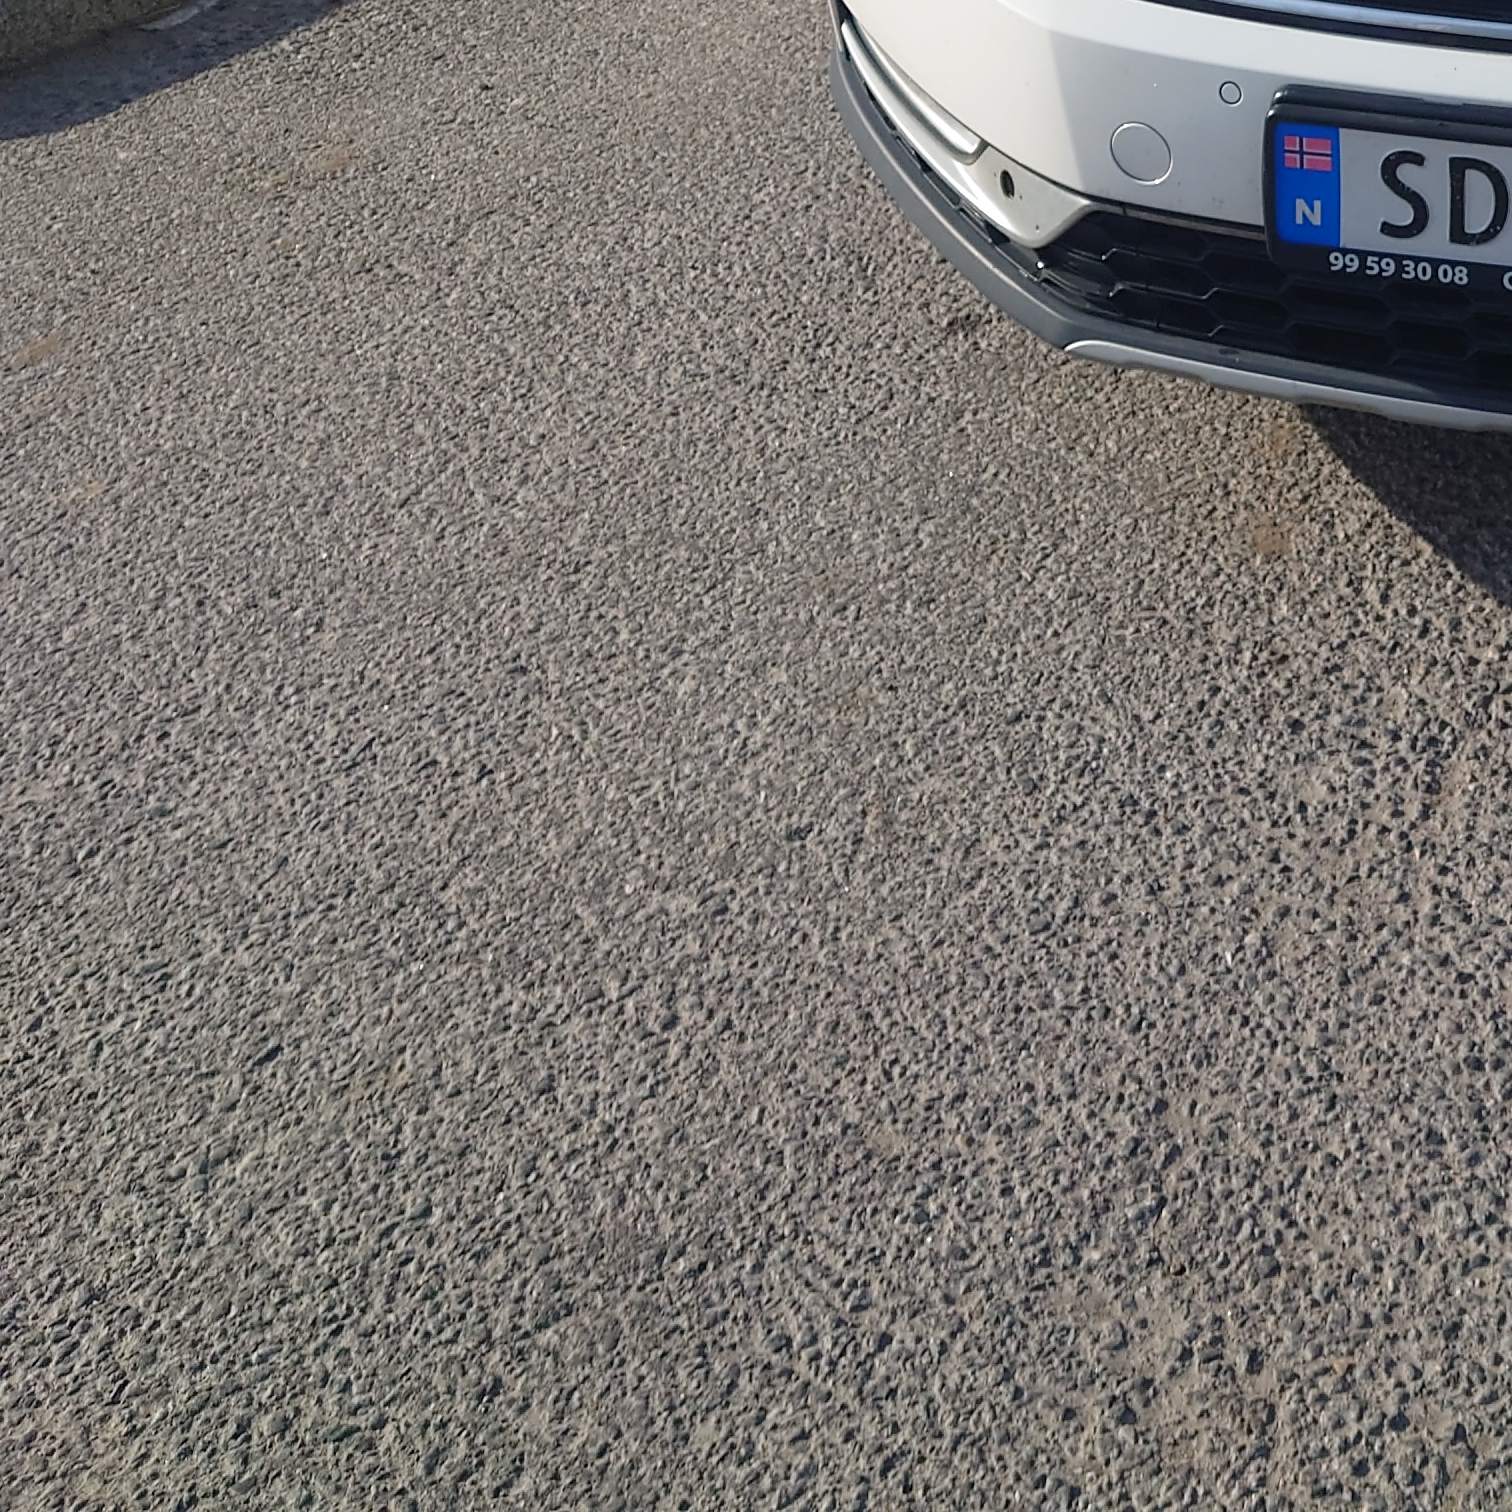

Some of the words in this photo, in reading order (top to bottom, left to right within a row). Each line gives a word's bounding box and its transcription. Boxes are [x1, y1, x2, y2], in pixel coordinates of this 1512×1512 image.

[1295, 198, 1321, 225] N
[1380, 149, 1509, 245] SD
[1328, 252, 1359, 272] 99
[1365, 256, 1395, 277] 59
[1401, 260, 1431, 281] 30
[1437, 263, 1469, 285] 08
